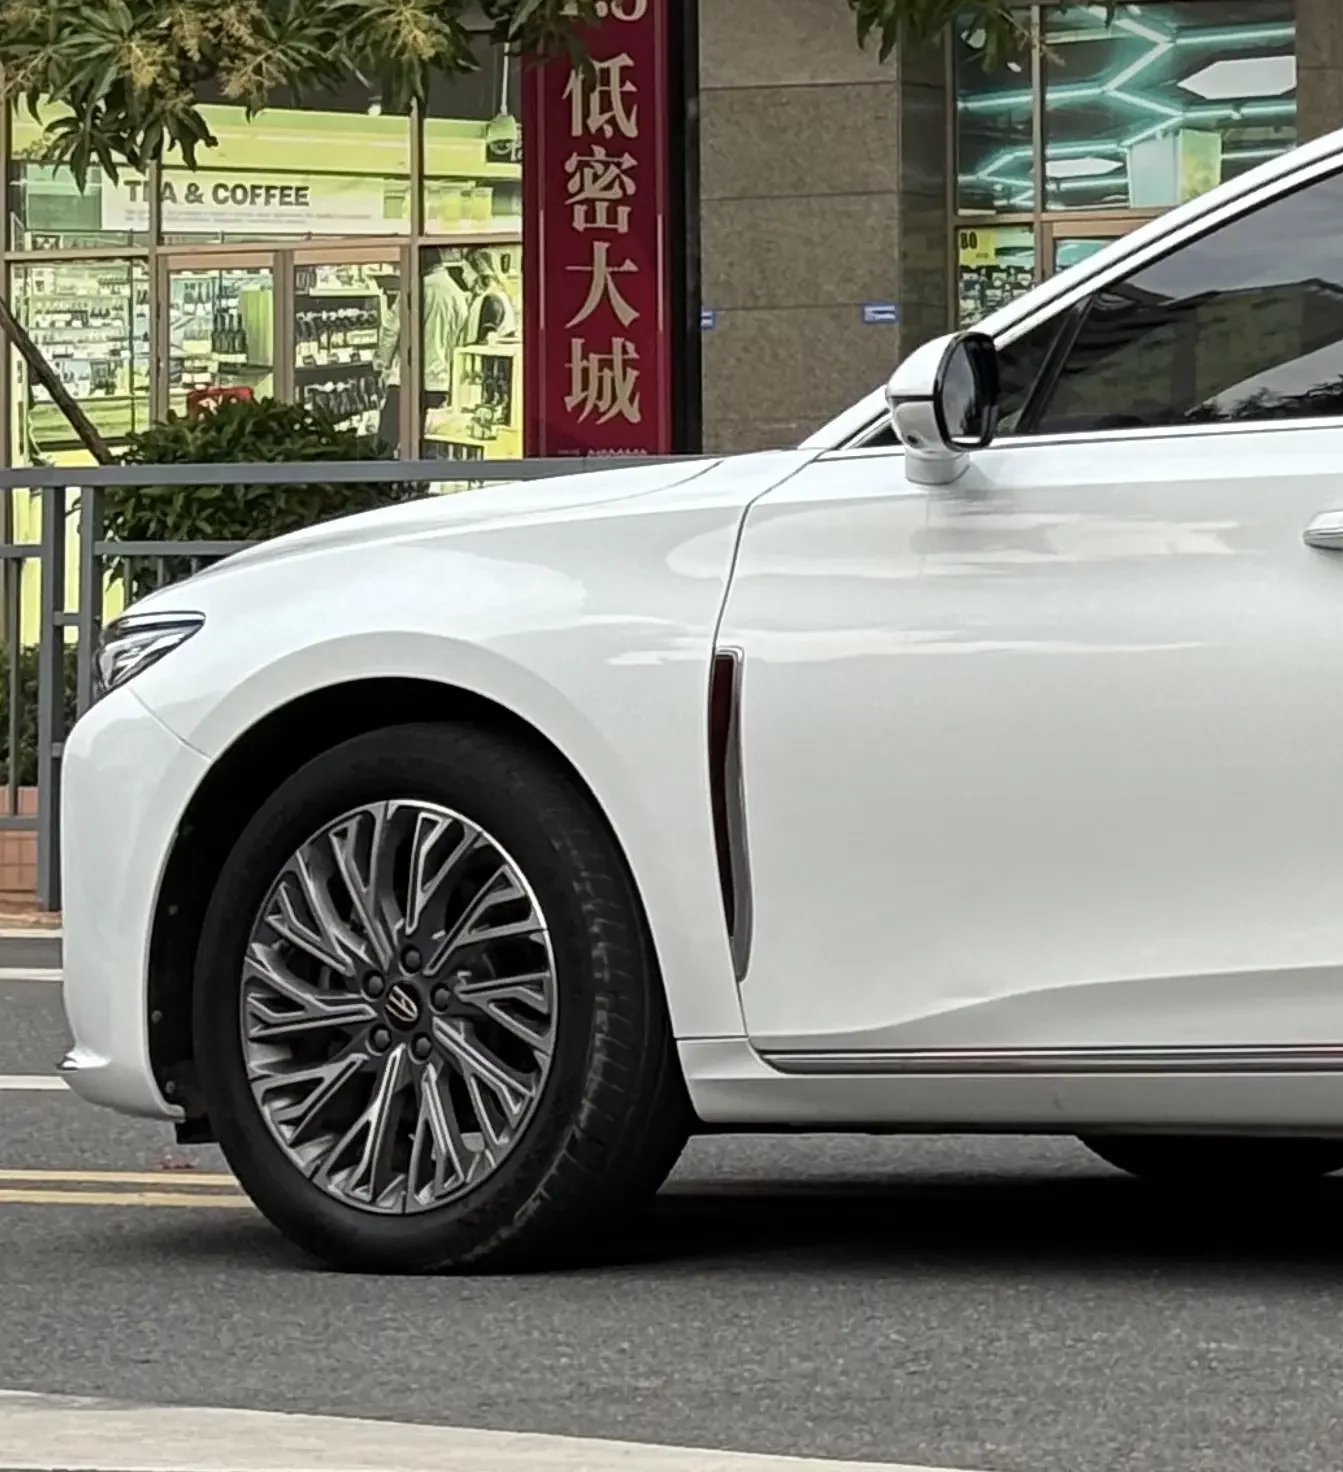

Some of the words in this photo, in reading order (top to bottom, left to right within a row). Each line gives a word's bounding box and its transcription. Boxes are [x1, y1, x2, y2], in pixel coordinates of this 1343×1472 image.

[123, 180, 178, 204] TA
[184, 182, 205, 205] &
[211, 183, 310, 207] COFFEE
[562, 52, 641, 425] 低密大城
